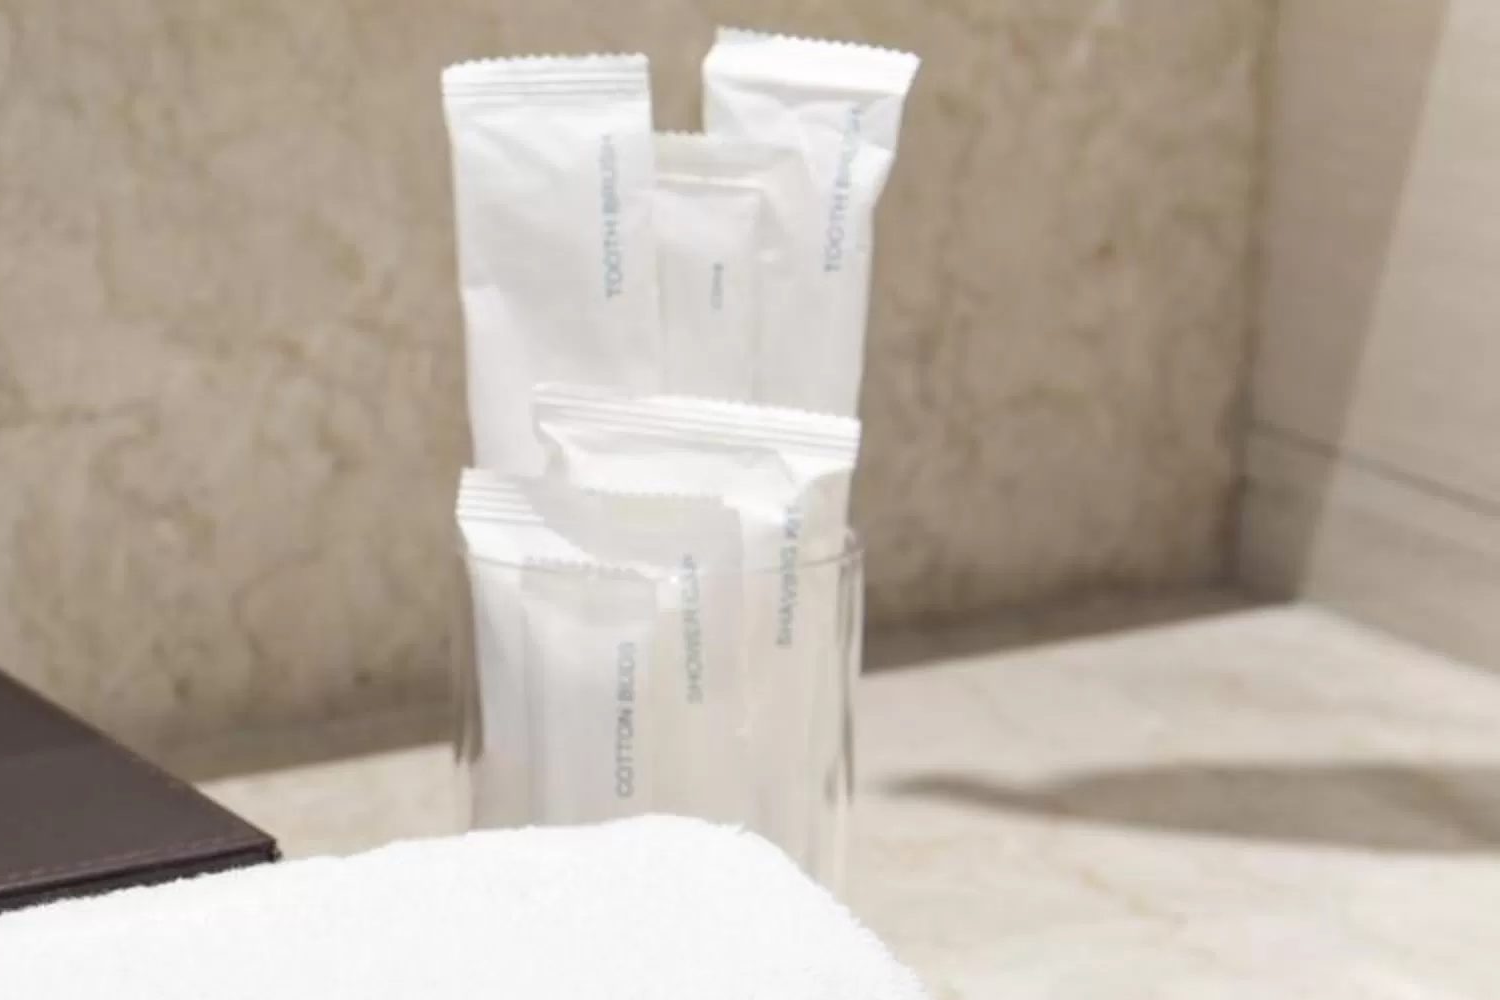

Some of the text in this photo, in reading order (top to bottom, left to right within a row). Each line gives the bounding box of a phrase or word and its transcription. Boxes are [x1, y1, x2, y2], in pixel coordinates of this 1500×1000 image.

[603, 219, 624, 298] TOOTH
[823, 194, 849, 273] TOOTH
[615, 706, 635, 799] COTTON
